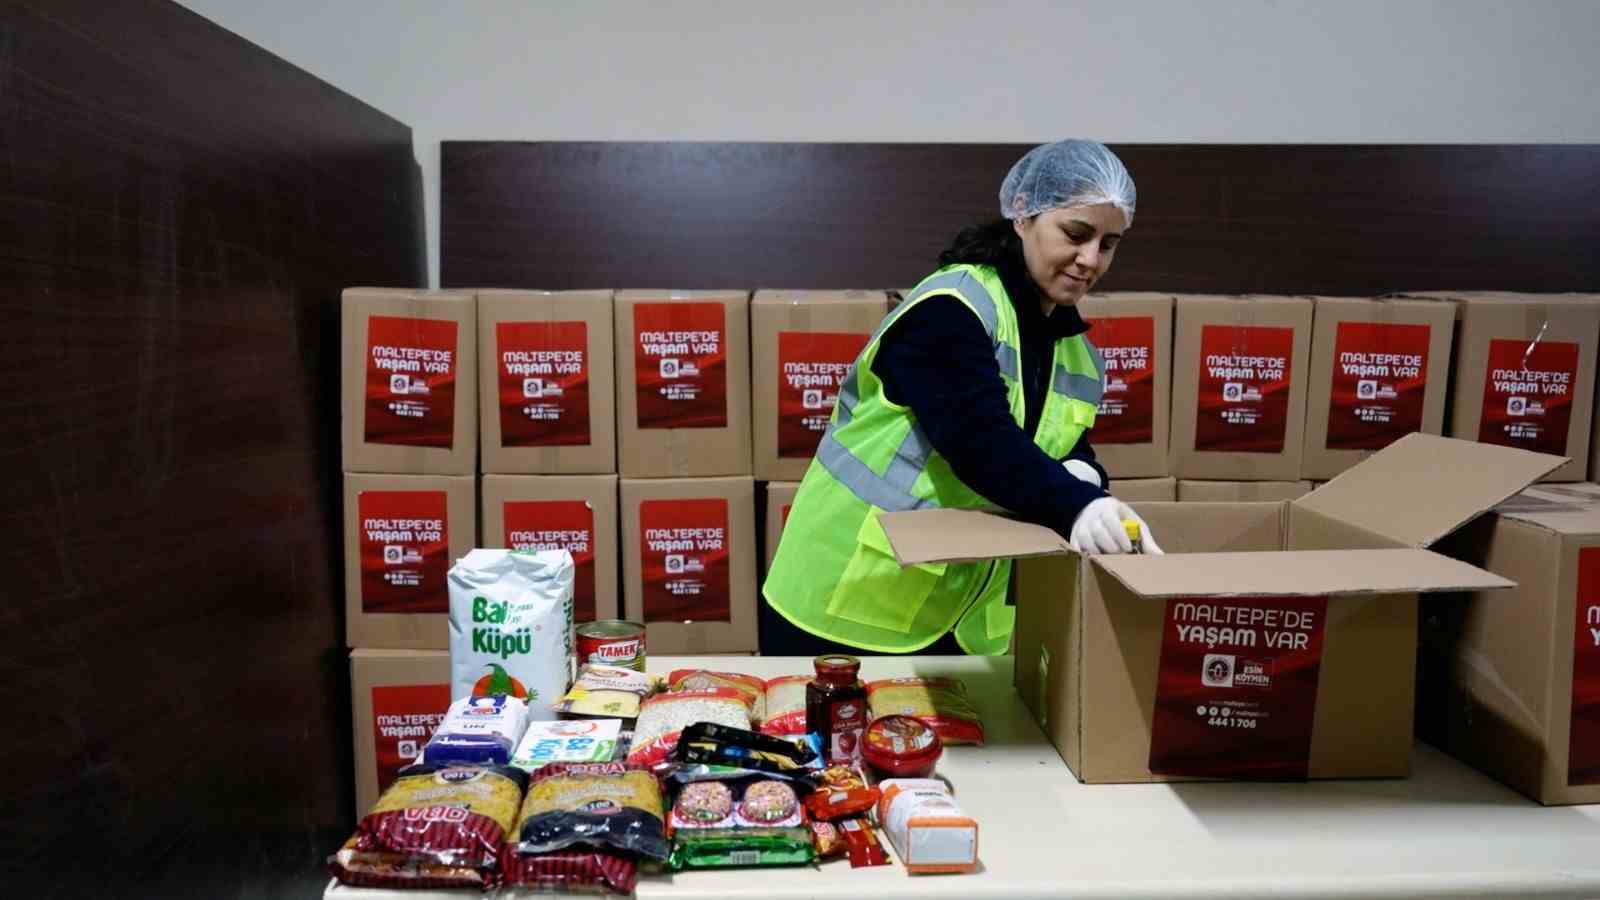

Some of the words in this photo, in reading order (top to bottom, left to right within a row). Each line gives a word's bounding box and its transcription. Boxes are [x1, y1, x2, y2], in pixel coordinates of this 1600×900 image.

[640, 331, 719, 343] MALTEPE'DE
[372, 346, 451, 362] MALTEPE'DE
[643, 343, 688, 356] YAŞAM
[693, 343, 718, 354] VAR
[504, 351, 582, 363] MALTEPE'DE
[1206, 355, 1285, 369] MALTEPE'DE
[1340, 352, 1422, 366] MALTEPE'DE
[374, 358, 420, 372] YAŞAM
[424, 362, 449, 373] VAR
[506, 363, 552, 376] YAŞAM
[556, 363, 581, 374] VAR
[1120, 359, 1147, 369] VAR
[1208, 367, 1254, 381] YAŞAM
[1258, 369, 1283, 380] VAR
[1342, 364, 1389, 378] YAŞAM
[1392, 366, 1419, 377] VAR
[1492, 369, 1570, 383] MALTEPE'DE
[1494, 382, 1538, 395] YAŞAM
[1542, 384, 1567, 395] VAR
[364, 519, 442, 531] MALTEPE'DE
[367, 531, 412, 544] YAŞAM
[417, 531, 441, 542] VAR
[510, 530, 589, 542] MALTEPE'DE
[646, 528, 724, 540] MALTEPE'DE
[649, 540, 694, 553] YAŞAM
[697, 540, 722, 550] VAR
[1174, 603, 1315, 629] MALTEPE'DE
[472, 627, 531, 660] Küpü
[1176, 624, 1257, 649] YAŞAM
[1264, 631, 1309, 650] VAR
[600, 643, 637, 657] TAMEK
[380, 725, 426, 738] YAŞAM
